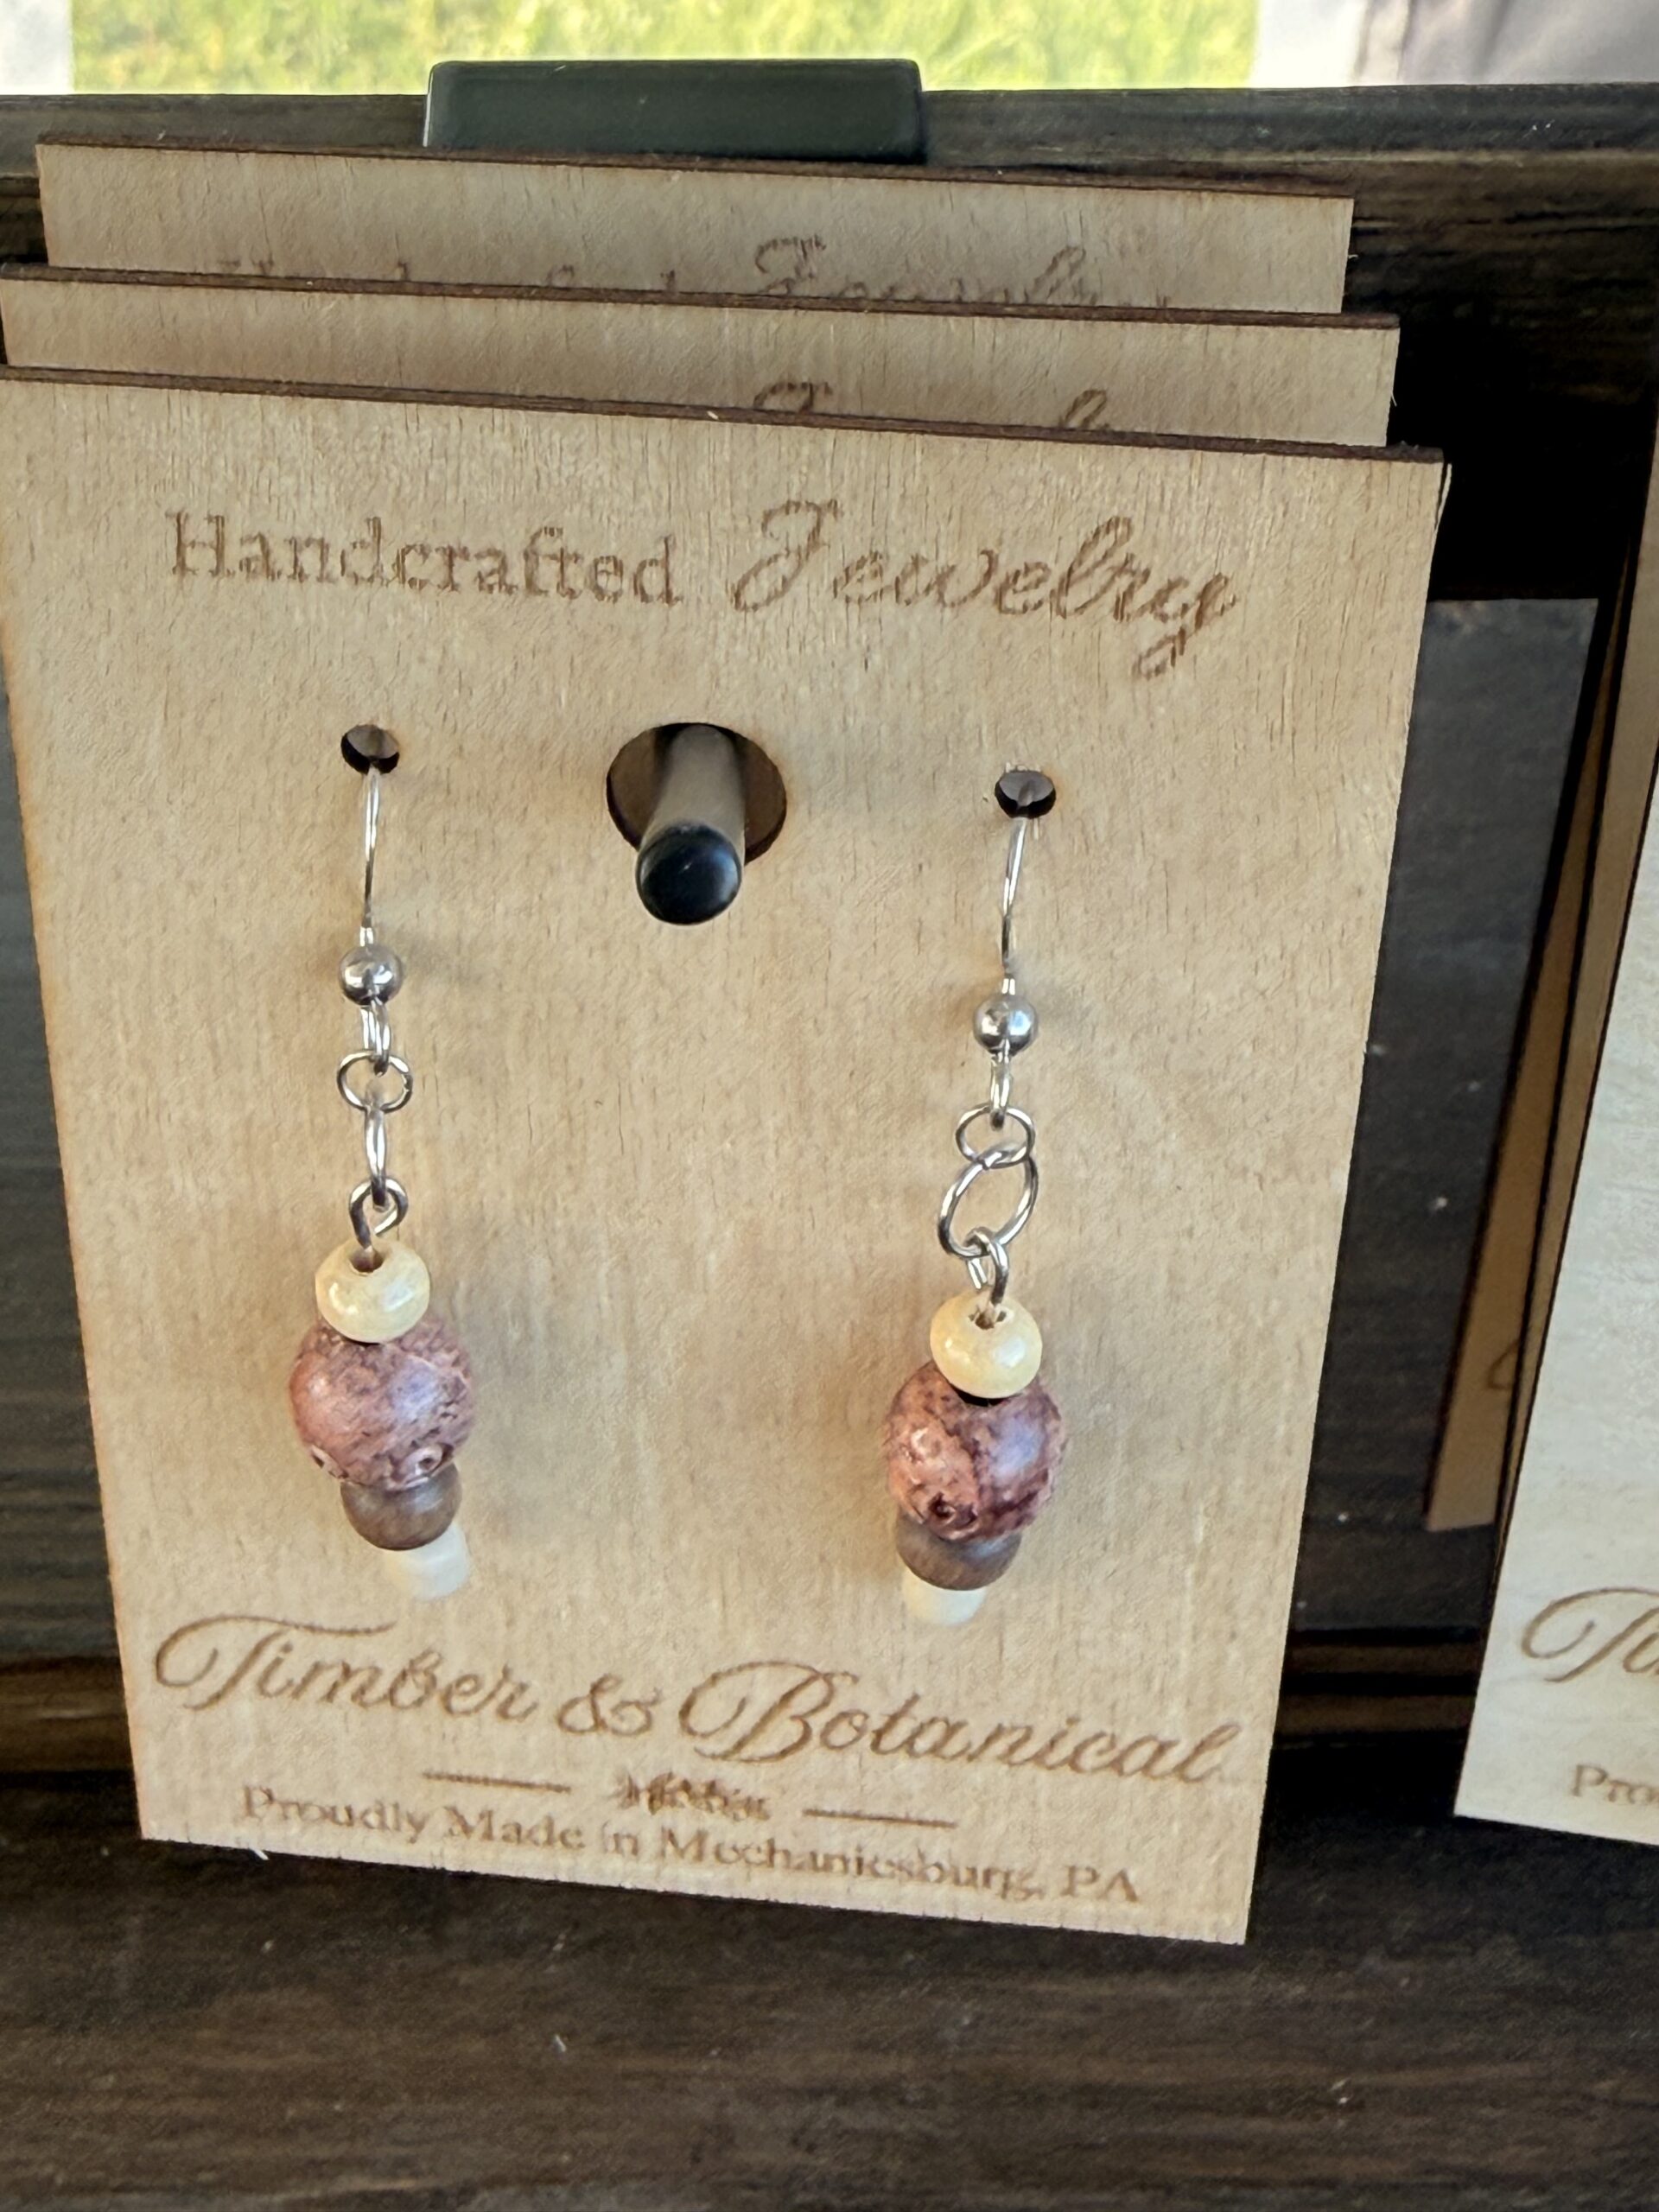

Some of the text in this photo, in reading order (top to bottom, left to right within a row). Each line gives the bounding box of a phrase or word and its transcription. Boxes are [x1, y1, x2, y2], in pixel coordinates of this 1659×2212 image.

[167, 499, 1237, 679] Handcrafted Jewelry
[156, 1614, 1243, 1783] Timber & Botanical
[241, 1784, 429, 1845] Proudly
[444, 1803, 586, 1851] Made
[603, 1818, 640, 1858] in
[1059, 1864, 1139, 1903] PA
